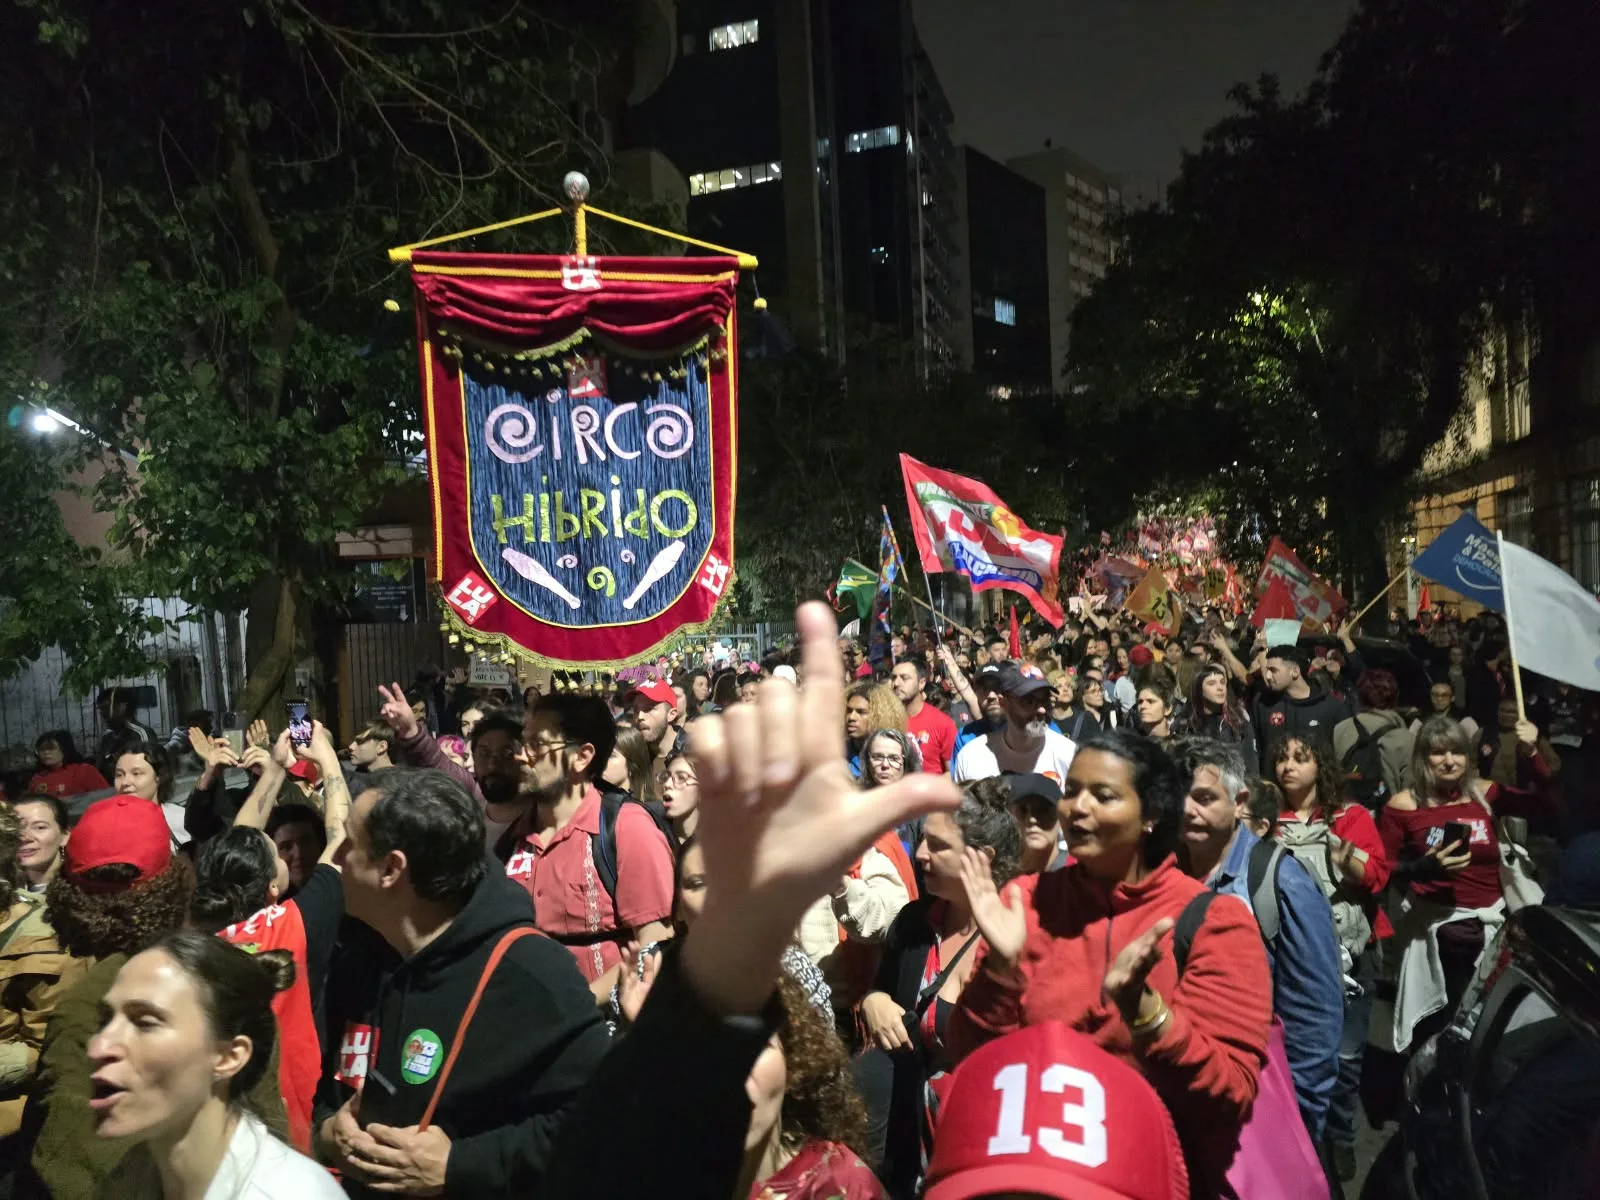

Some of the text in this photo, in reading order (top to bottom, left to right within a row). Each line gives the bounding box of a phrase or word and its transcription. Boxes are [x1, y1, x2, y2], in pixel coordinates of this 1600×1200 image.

[340, 1031, 372, 1054] LU
[340, 1054, 368, 1078] LA
[987, 1062, 1109, 1169] 13
